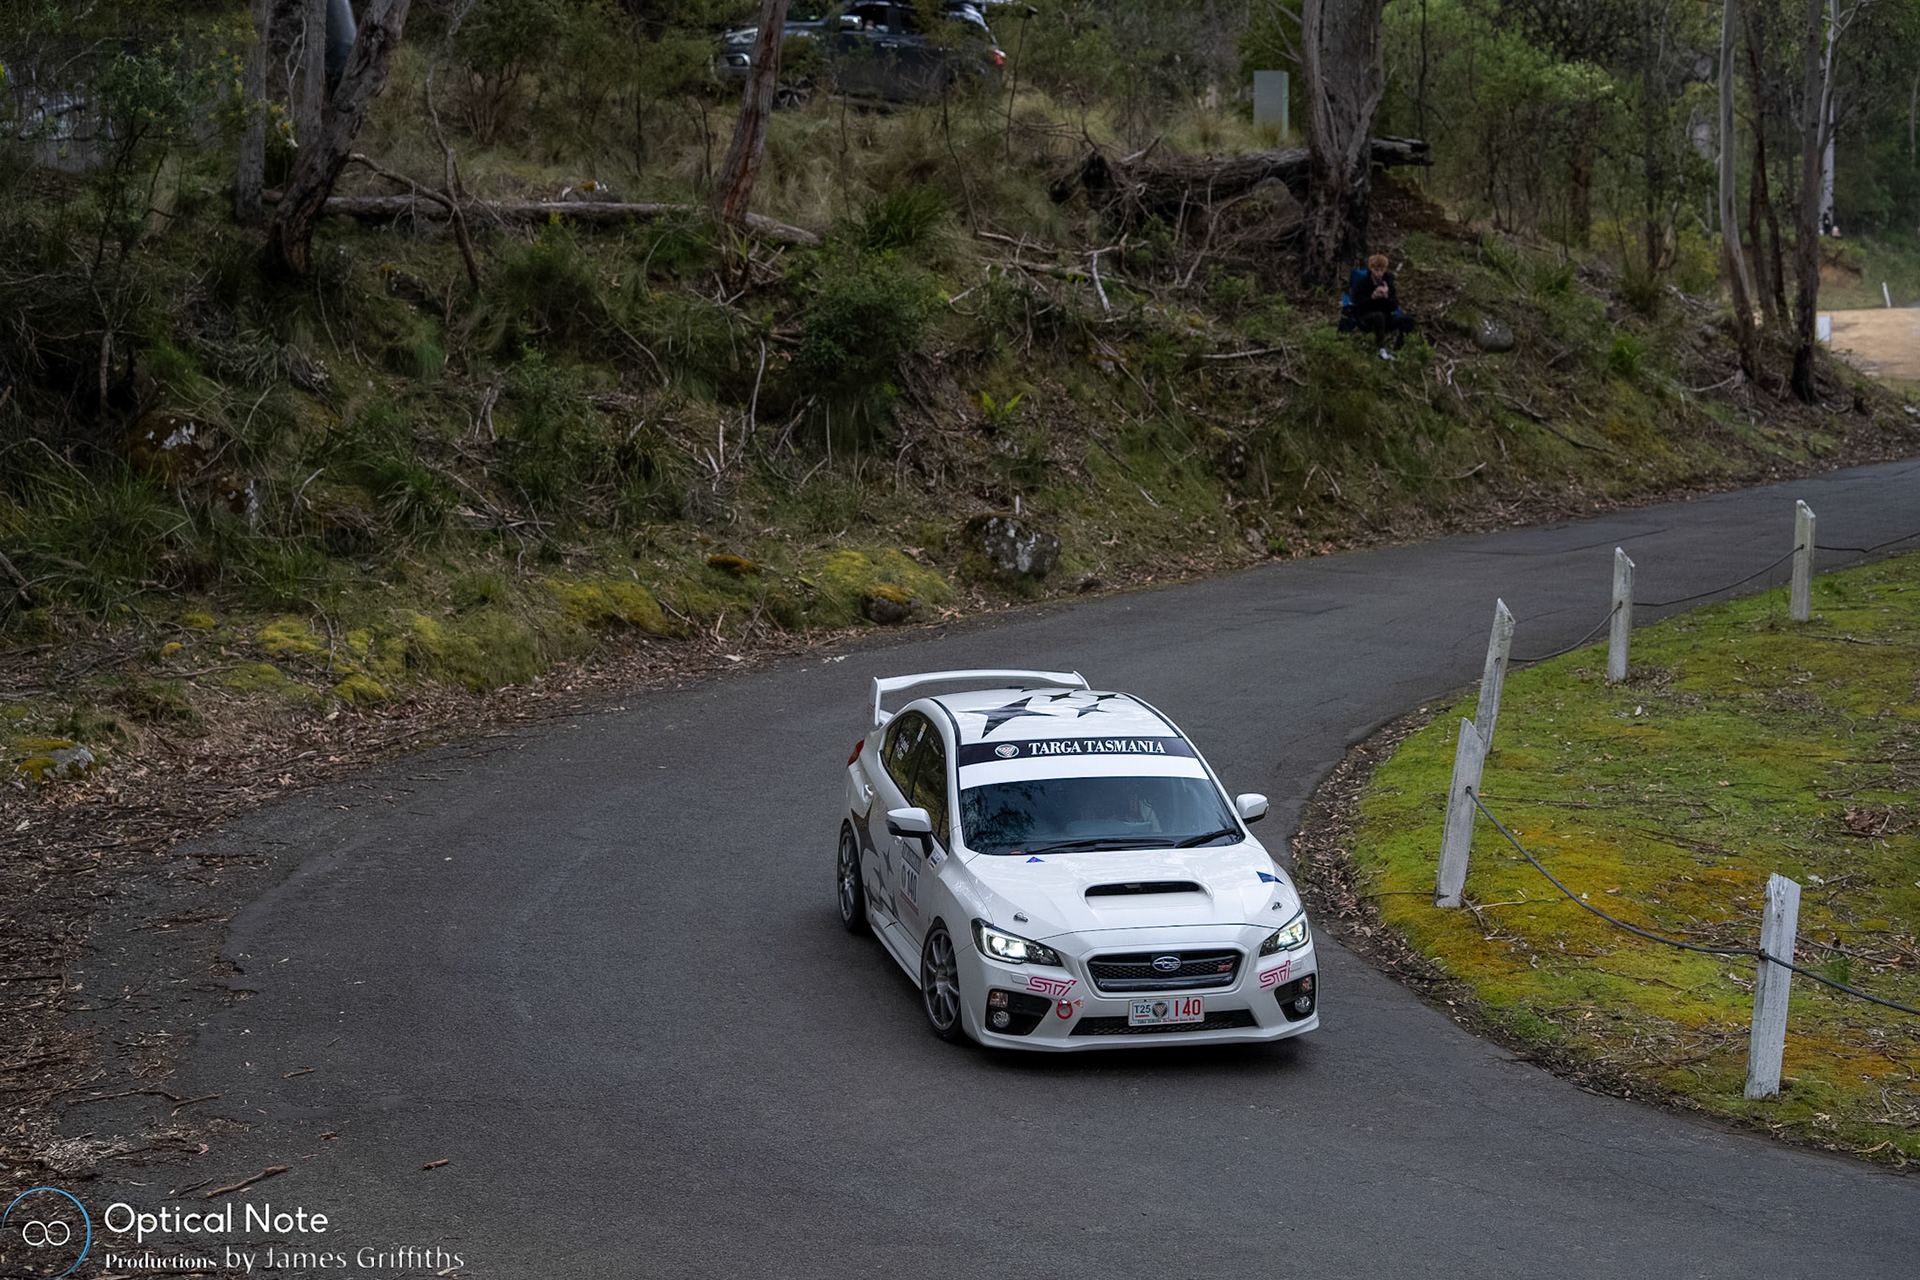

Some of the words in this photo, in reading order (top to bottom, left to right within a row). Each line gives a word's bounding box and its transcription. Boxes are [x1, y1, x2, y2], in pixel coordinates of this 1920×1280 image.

[1029, 739, 1081, 756] TARGA
[1084, 739, 1166, 755] TASMANIA
[1134, 1004, 1151, 1014] T25
[1175, 998, 1201, 1017] 140
